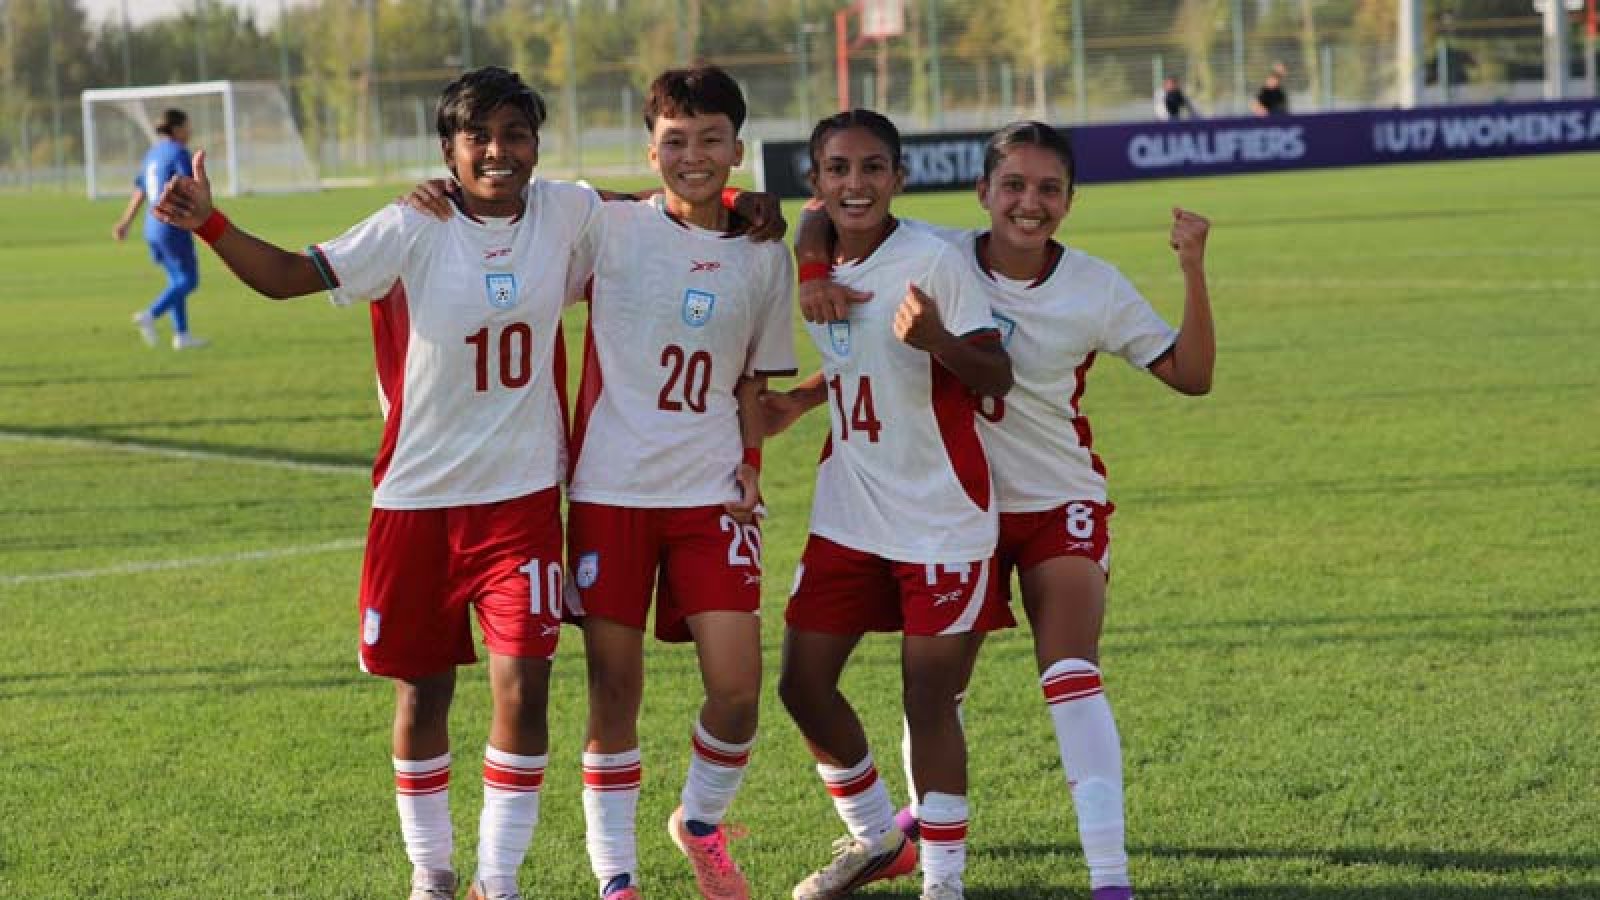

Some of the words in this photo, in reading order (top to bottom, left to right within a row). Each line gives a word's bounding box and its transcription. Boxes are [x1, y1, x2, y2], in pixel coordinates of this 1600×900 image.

[1128, 126, 1306, 168] QUALIFIERS
[1439, 111, 1586, 149] WOMEN'S
[465, 321, 533, 392] 10
[657, 343, 713, 413] 20
[829, 373, 883, 443] 14
[720, 513, 764, 569] 20
[1066, 503, 1094, 539] 8
[518, 558, 562, 619] 10
